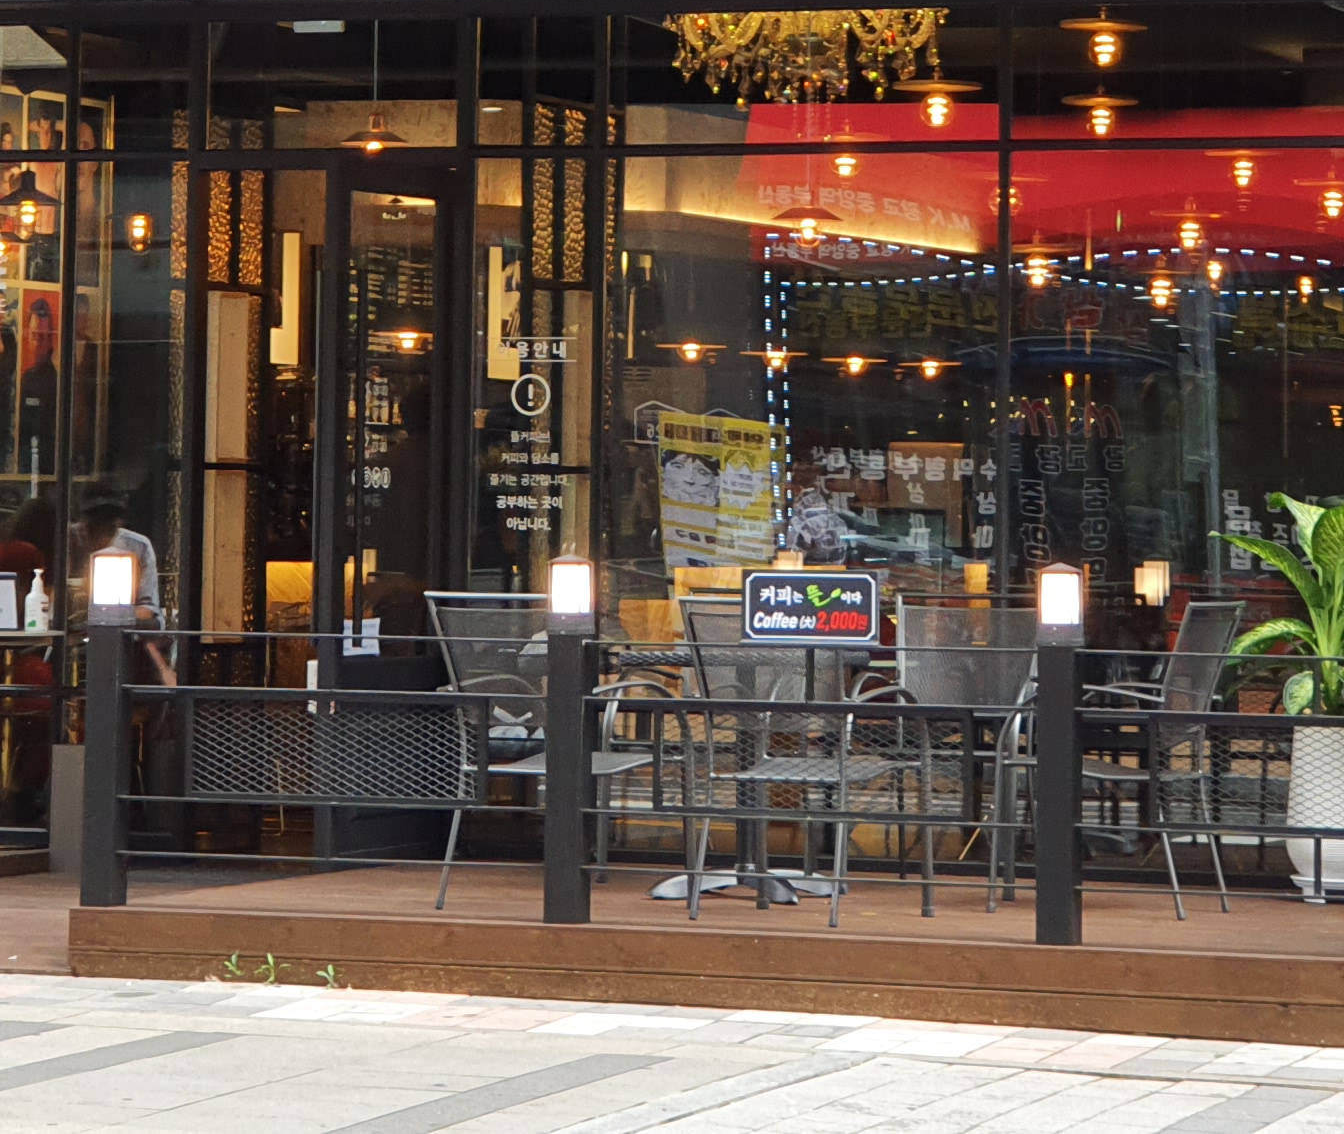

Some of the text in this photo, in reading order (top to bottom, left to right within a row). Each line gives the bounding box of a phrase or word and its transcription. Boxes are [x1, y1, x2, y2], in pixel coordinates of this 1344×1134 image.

[496, 495, 564, 510] 공부하는 곳이
[505, 516, 552, 532] 아닙니다.
[759, 585, 805, 606] 커피는
[839, 590, 864, 605] 이다
[752, 610, 799, 630] Coffee
